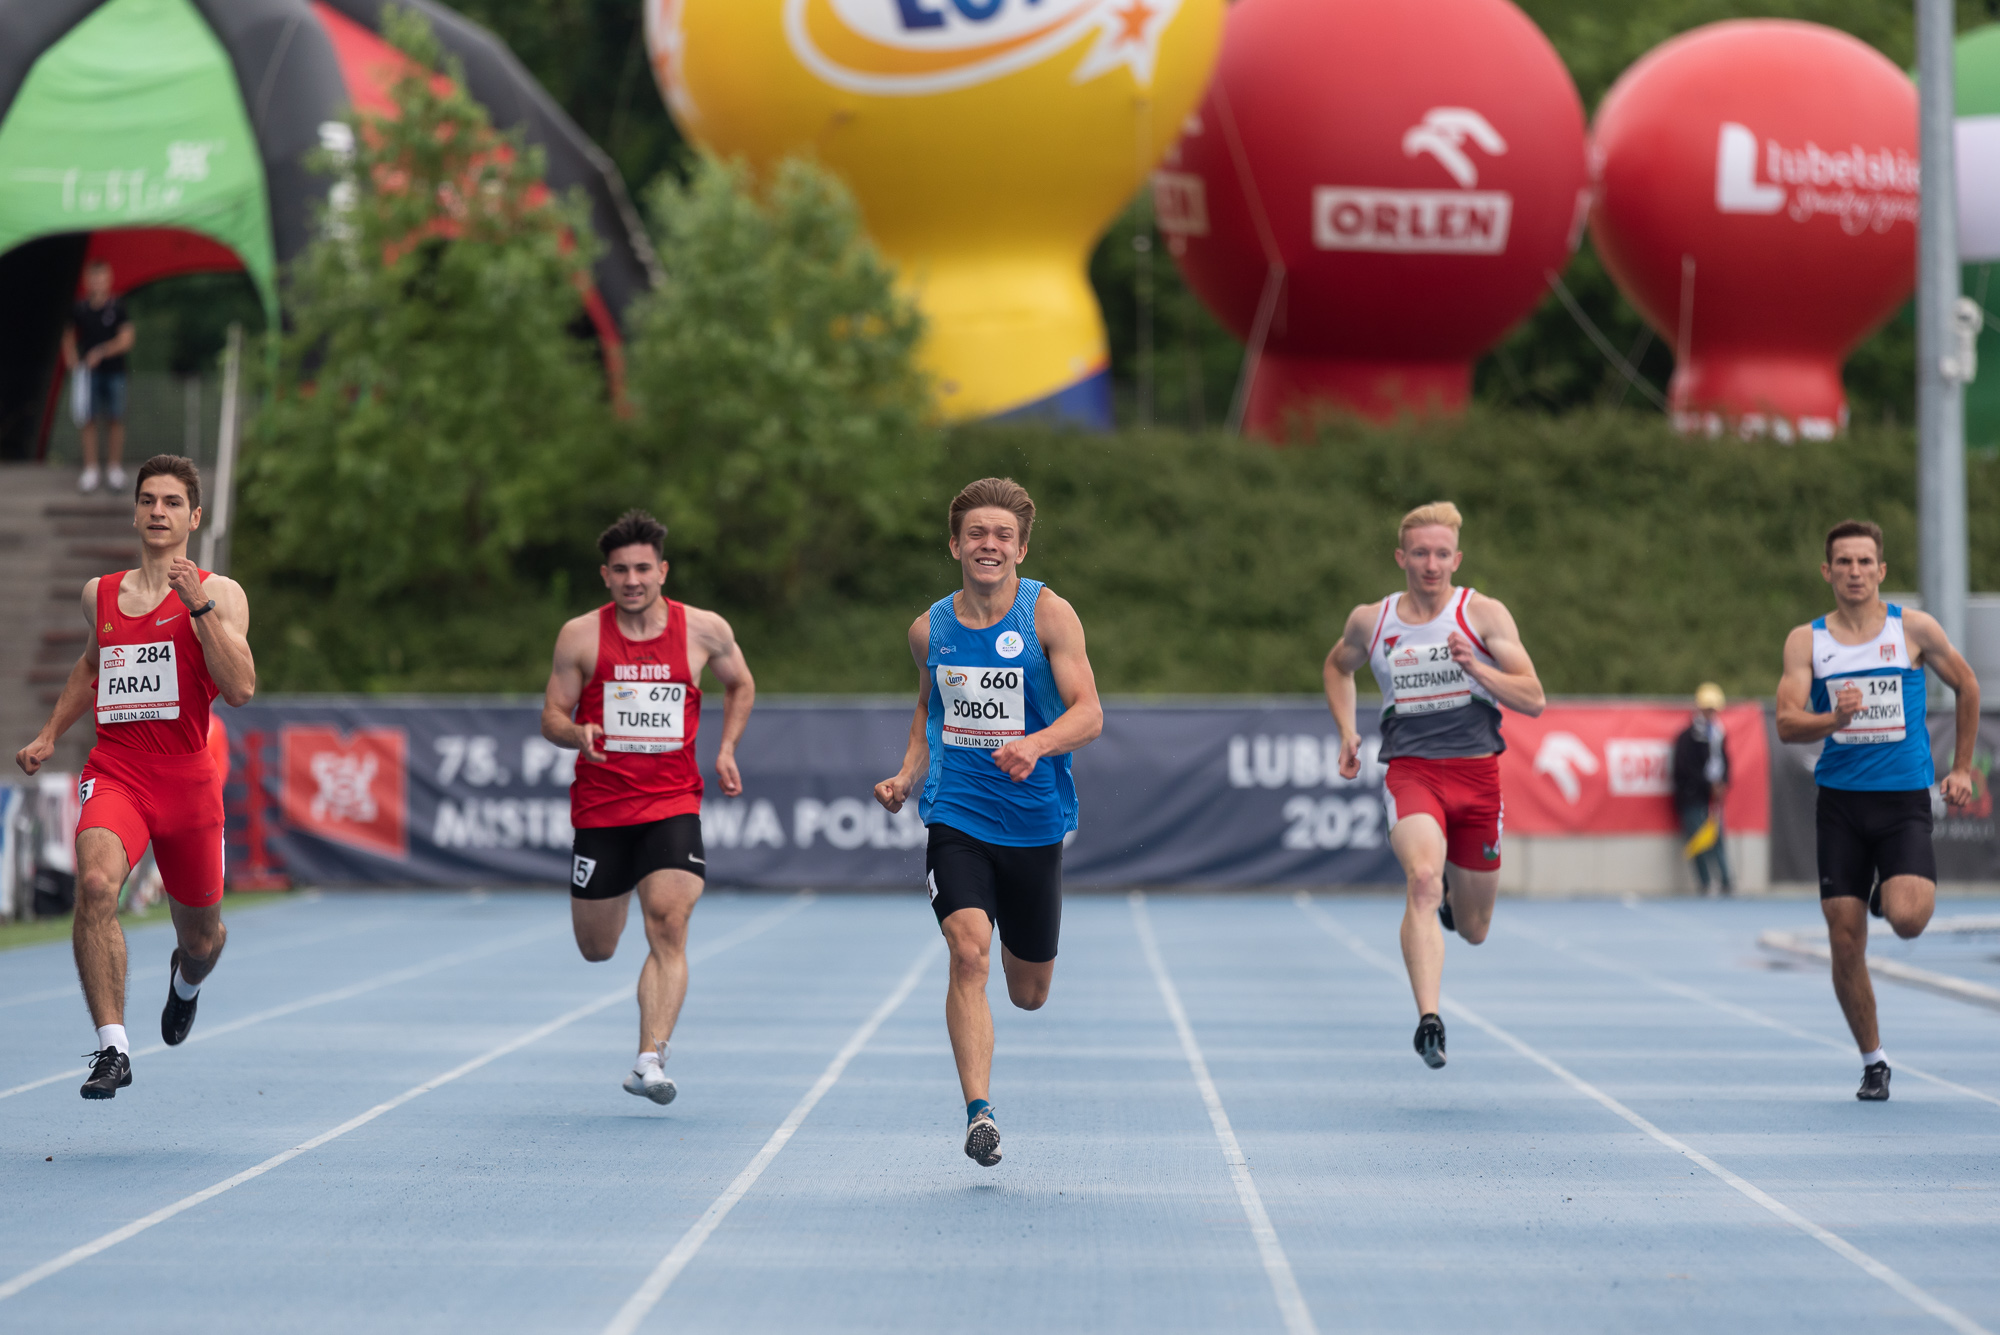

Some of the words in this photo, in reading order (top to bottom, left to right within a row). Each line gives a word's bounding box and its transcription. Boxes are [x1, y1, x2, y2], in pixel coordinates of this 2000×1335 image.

[1329, 201, 1495, 241] ORLEN
[136, 645, 171, 664] 284
[105, 659, 124, 668] ORLEN
[614, 664, 638, 680] UKS
[640, 663, 671, 680] ATOS
[108, 675, 161, 695] FARAJ
[980, 671, 1018, 689] 660
[1393, 668, 1464, 690] SZCZEPANIAK
[649, 687, 681, 702] 670
[1868, 680, 1897, 696] 194
[110, 711, 137, 721] LUBLIN
[139, 711, 160, 719] 2021
[953, 698, 1009, 719] SOBÓL
[617, 712, 671, 728] TUREK
[955, 736, 981, 746] LUBLIN
[983, 739, 1004, 747] 2021
[576, 860, 587, 884] 5
